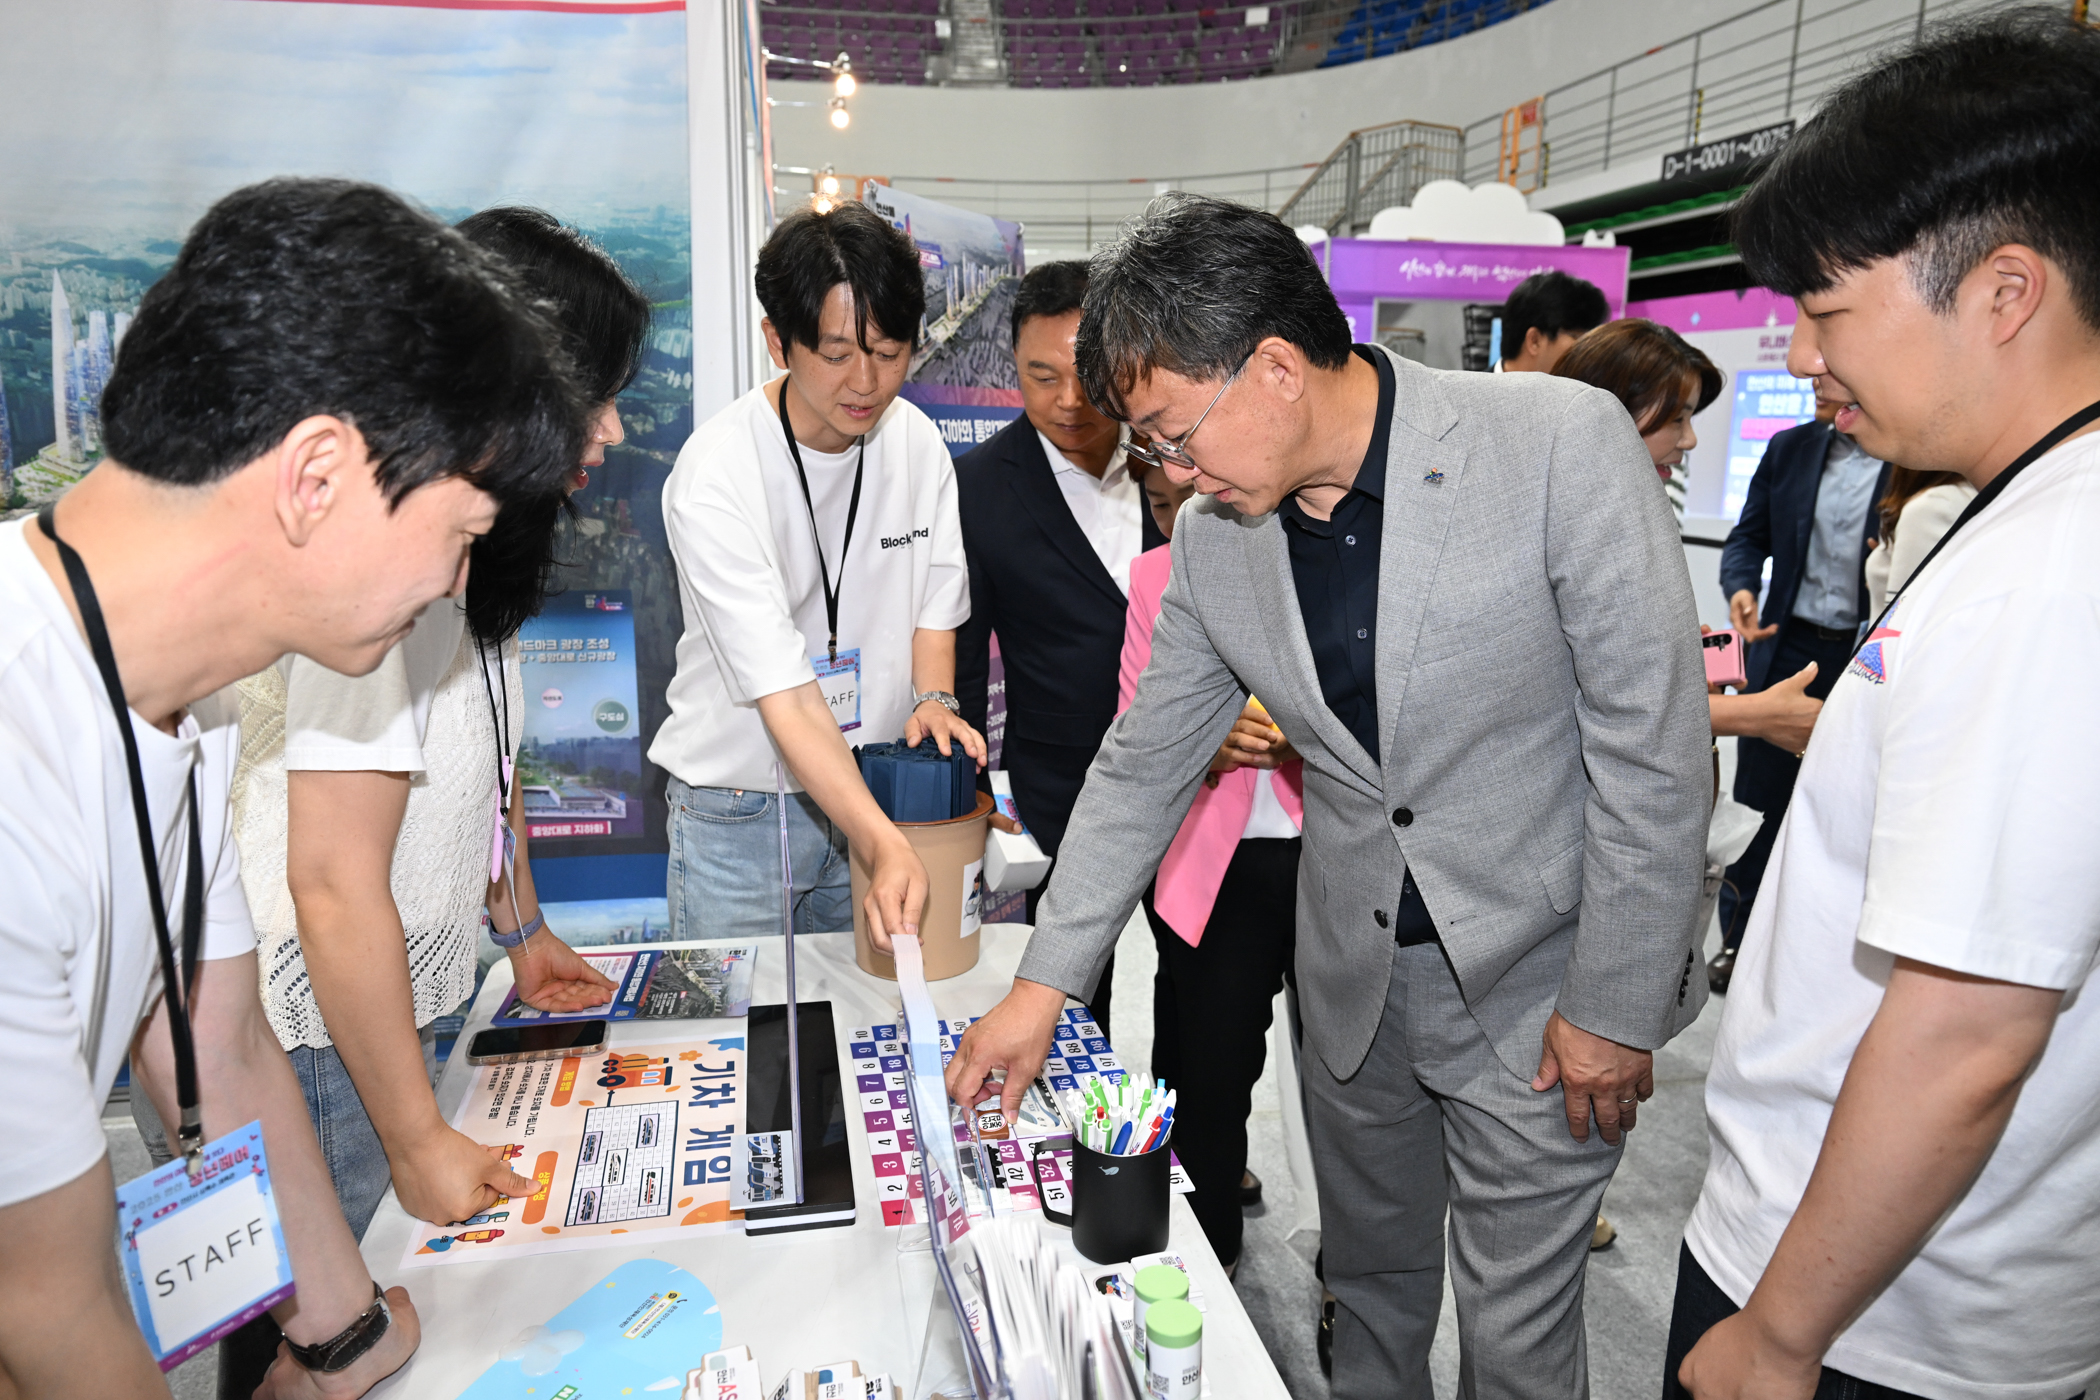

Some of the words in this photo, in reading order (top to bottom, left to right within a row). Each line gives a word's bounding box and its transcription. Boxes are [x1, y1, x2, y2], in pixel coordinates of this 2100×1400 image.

[939, 419, 973, 444] 지하화
[587, 638, 610, 650] 조성
[599, 712, 625, 722] 구도심
[574, 824, 604, 834] 지하화
[855, 1030, 868, 1038] 10
[880, 1027, 894, 1038] 20
[1072, 1009, 1089, 1022] 100
[885, 1043, 898, 1052] 19
[1057, 1027, 1073, 1038] 89
[1081, 1025, 1097, 1036] 99
[888, 1059, 902, 1069] 18
[1065, 1042, 1081, 1054] 88
[1090, 1040, 1106, 1052] 98
[1048, 1063, 1065, 1072] 77
[1073, 1059, 1090, 1070] 87
[1099, 1057, 1116, 1067] 97
[562, 1070, 575, 1081] 게임
[516, 1083, 527, 1095] 숫자를
[688, 1060, 736, 1109] 기차
[1057, 1078, 1073, 1090] 76
[493, 1093, 507, 1106] 있으면
[513, 1095, 524, 1104] 하나
[529, 1097, 543, 1111] 숫자를
[873, 1117, 888, 1125] 5
[878, 1138, 892, 1146] 4
[683, 1124, 735, 1187] 게임
[883, 1160, 898, 1169] 3
[1000, 1144, 1015, 1159] 43
[887, 1184, 903, 1192] 2
[1008, 1167, 1025, 1180] 42
[1038, 1163, 1056, 1178] 52
[1047, 1188, 1065, 1200] 51
[154, 1217, 264, 1298] STAFF
[1182, 1369, 1199, 1386] 안산
